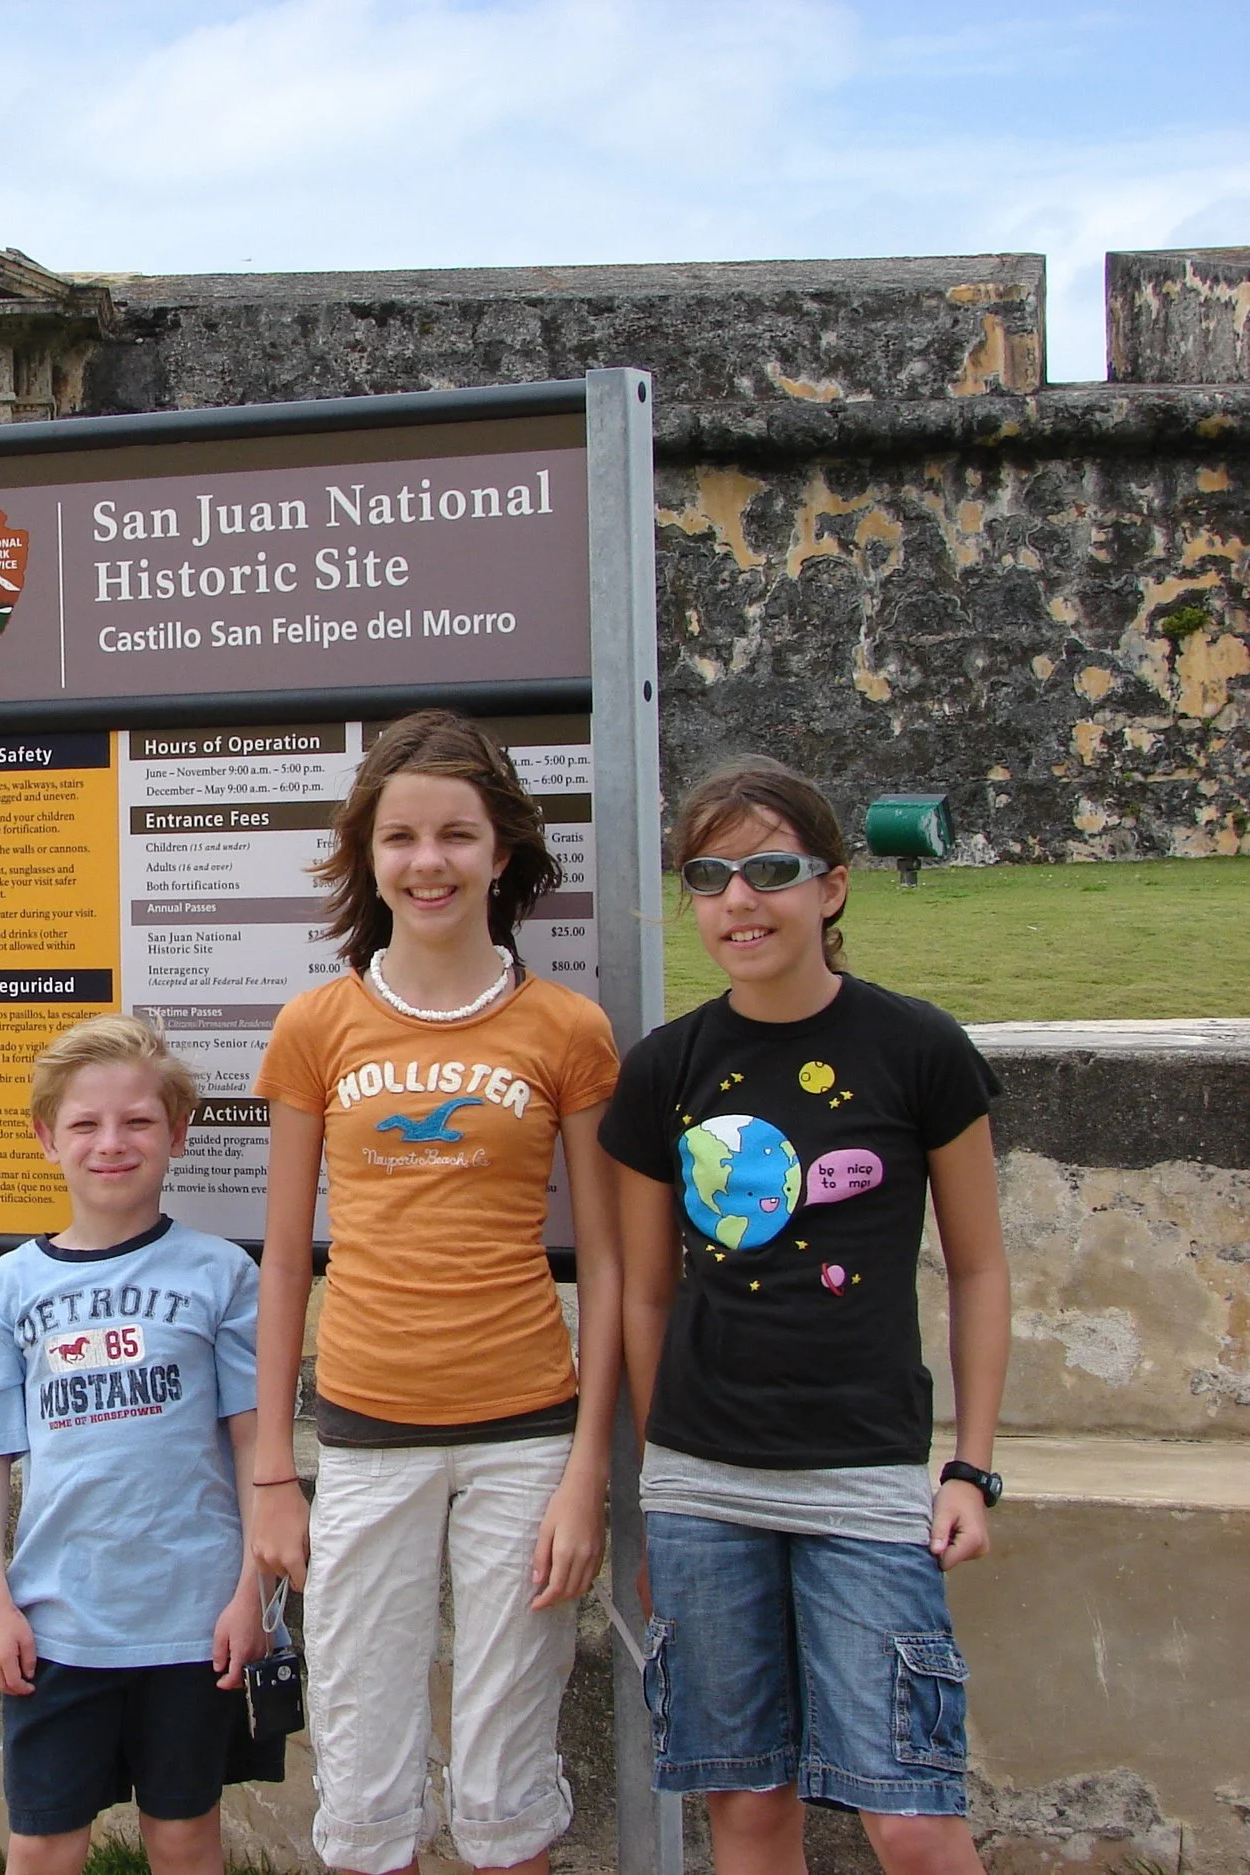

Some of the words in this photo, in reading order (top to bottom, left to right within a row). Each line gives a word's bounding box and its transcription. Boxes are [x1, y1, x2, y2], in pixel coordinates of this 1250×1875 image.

[93, 500, 180, 541] San
[192, 494, 309, 542] Juan
[325, 469, 552, 527] National
[94, 551, 297, 601] Historic
[315, 546, 408, 590] Site
[98, 621, 201, 652] Castillo
[210, 620, 261, 647] San
[272, 614, 357, 648] Felipe
[367, 610, 411, 639] del
[423, 609, 516, 636] Morro
[145, 739, 196, 754] Hours
[203, 736, 222, 752] of
[228, 734, 320, 754] Operation
[145, 768, 167, 780] June
[176, 766, 226, 777] November
[228, 764, 249, 775] 9:00
[250, 766, 271, 774] a.m.
[281, 763, 301, 773] 5:00
[303, 765, 325, 775] p.m.
[11, 780, 58, 791] walkways,
[59, 779, 84, 788] stairs
[146, 785, 195, 796] December
[204, 784, 225, 796] May
[227, 783, 248, 793] 9:00
[249, 785, 270, 793] a.m.
[279, 781, 300, 792] 6:00
[302, 783, 324, 794] p.m.
[23, 792, 41, 801] and
[42, 792, 78, 801] uneven.
[13, 814, 35, 824] your
[36, 812, 75, 821] children
[146, 812, 223, 828] Entrance
[230, 810, 269, 826] Fees
[3, 824, 60, 834] fortification.
[551, 832, 583, 842] Gratis
[12, 845, 35, 854] walls
[36, 846, 47, 854] or
[48, 845, 90, 853] cannons.
[555, 853, 584, 865] $3.00
[146, 880, 169, 891] Both
[171, 880, 240, 890] fortifications
[146, 902, 182, 913] Annual
[184, 902, 216, 912] Passes
[19, 909, 50, 920] during
[51, 910, 73, 920] your
[74, 908, 97, 917] visit.
[8, 929, 38, 938] drinks
[39, 929, 68, 939] (other
[147, 932, 166, 942] San
[168, 931, 192, 944] Juan
[196, 931, 241, 941] National
[551, 926, 585, 937] $25.00
[148, 944, 190, 954] Historic
[193, 943, 213, 954] Site
[148, 964, 209, 977] Interagency
[308, 963, 340, 973] $80.00
[552, 960, 586, 971] $80.00
[9, 1009, 46, 1021] pasillos,
[47, 1009, 60, 1019] las
[190, 1007, 222, 1016] Passes
[213, 1038, 248, 1048] Senior
[214, 1070, 250, 1080] Access
[207, 1083, 246, 1091] Disabled)
[337, 1060, 531, 1119] HOLLISTER
[8, 1149, 45, 1160] durante
[818, 1163, 835, 1177] be
[847, 1163, 873, 1175] nice
[821, 1177, 836, 1189] to
[14, 1285, 191, 1347] DETROIT
[104, 1327, 139, 1360] 85
[39, 1363, 183, 1419] MUSTANGS
[74, 1416, 88, 1426] OF
[89, 1405, 163, 1424] HORSEPOWER
